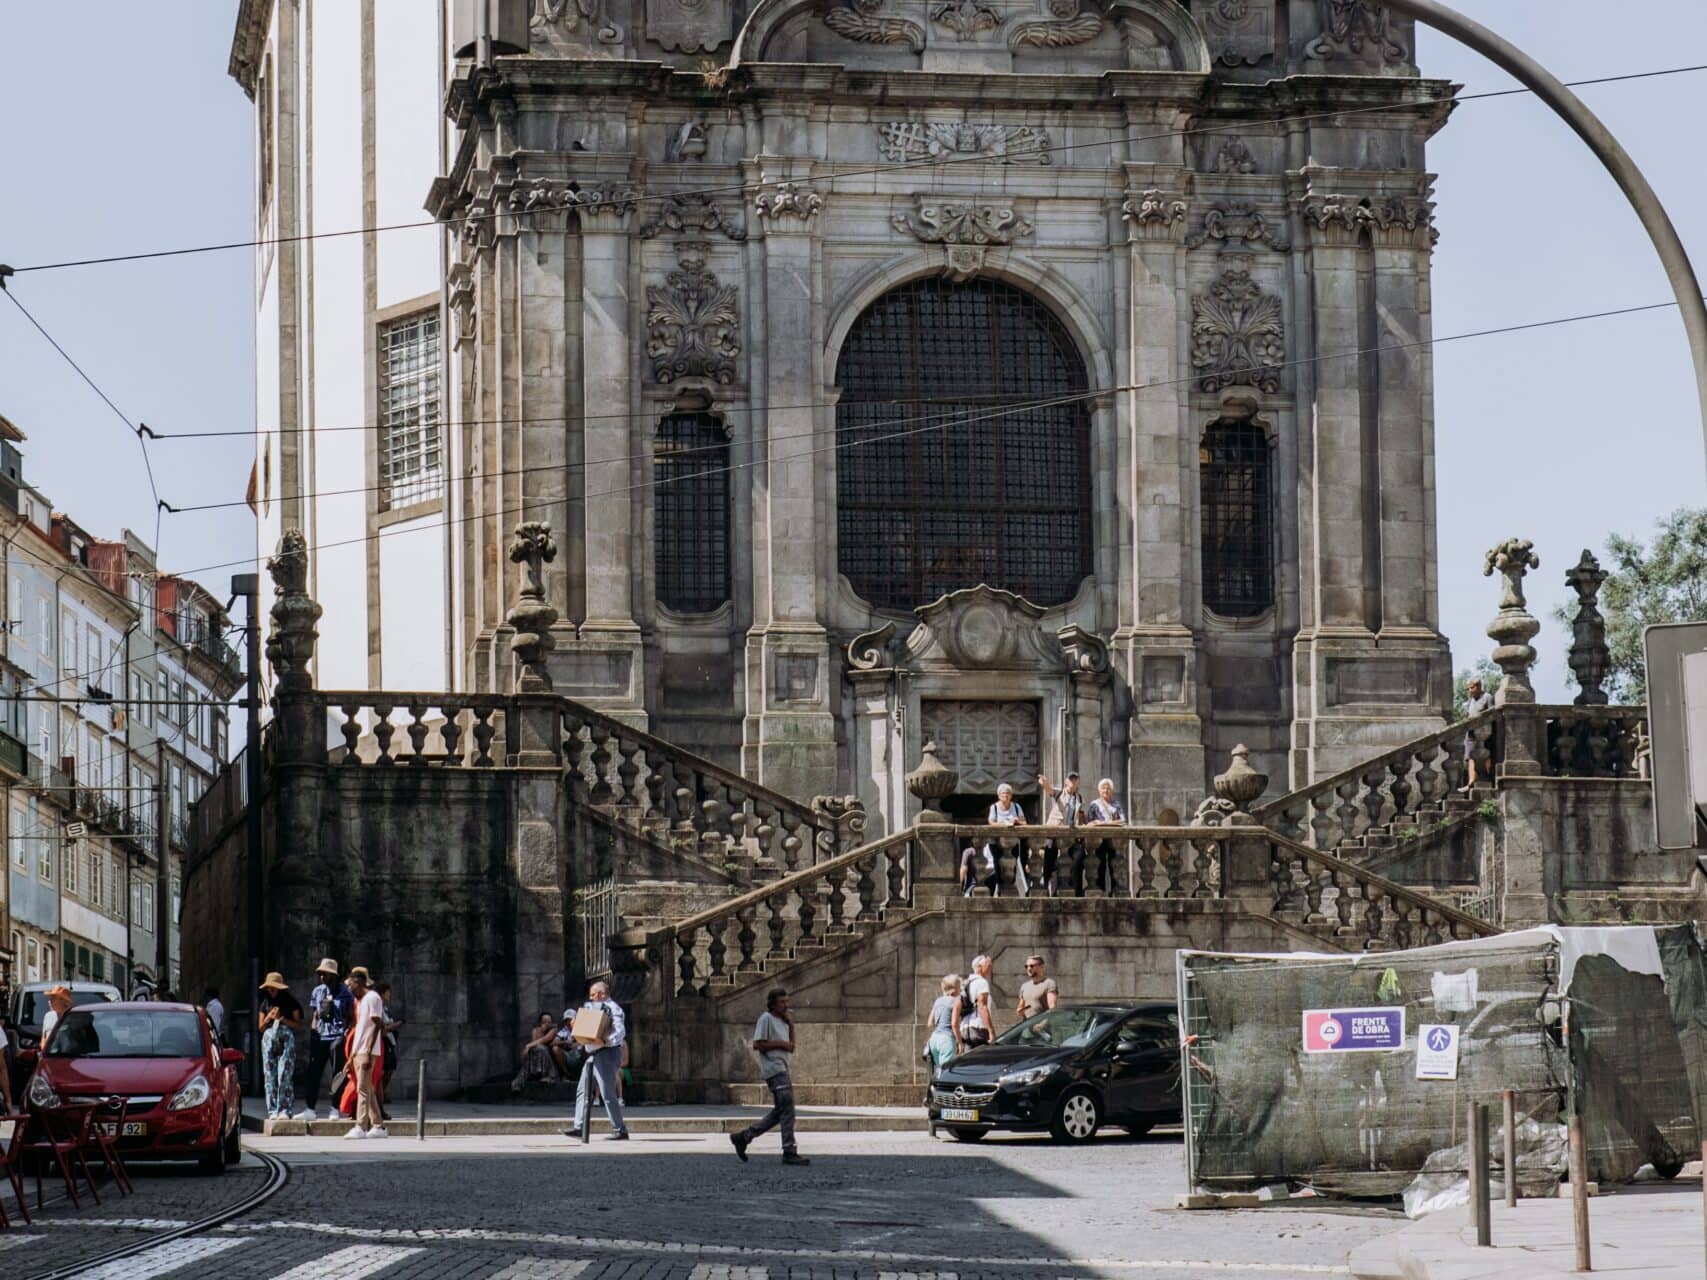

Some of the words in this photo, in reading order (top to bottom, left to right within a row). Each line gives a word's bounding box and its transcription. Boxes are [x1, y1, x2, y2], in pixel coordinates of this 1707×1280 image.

[1352, 1017, 1387, 1026] FRENTE
[1352, 1026, 1364, 1034] DE
[1365, 1024, 1390, 1034] OBRA
